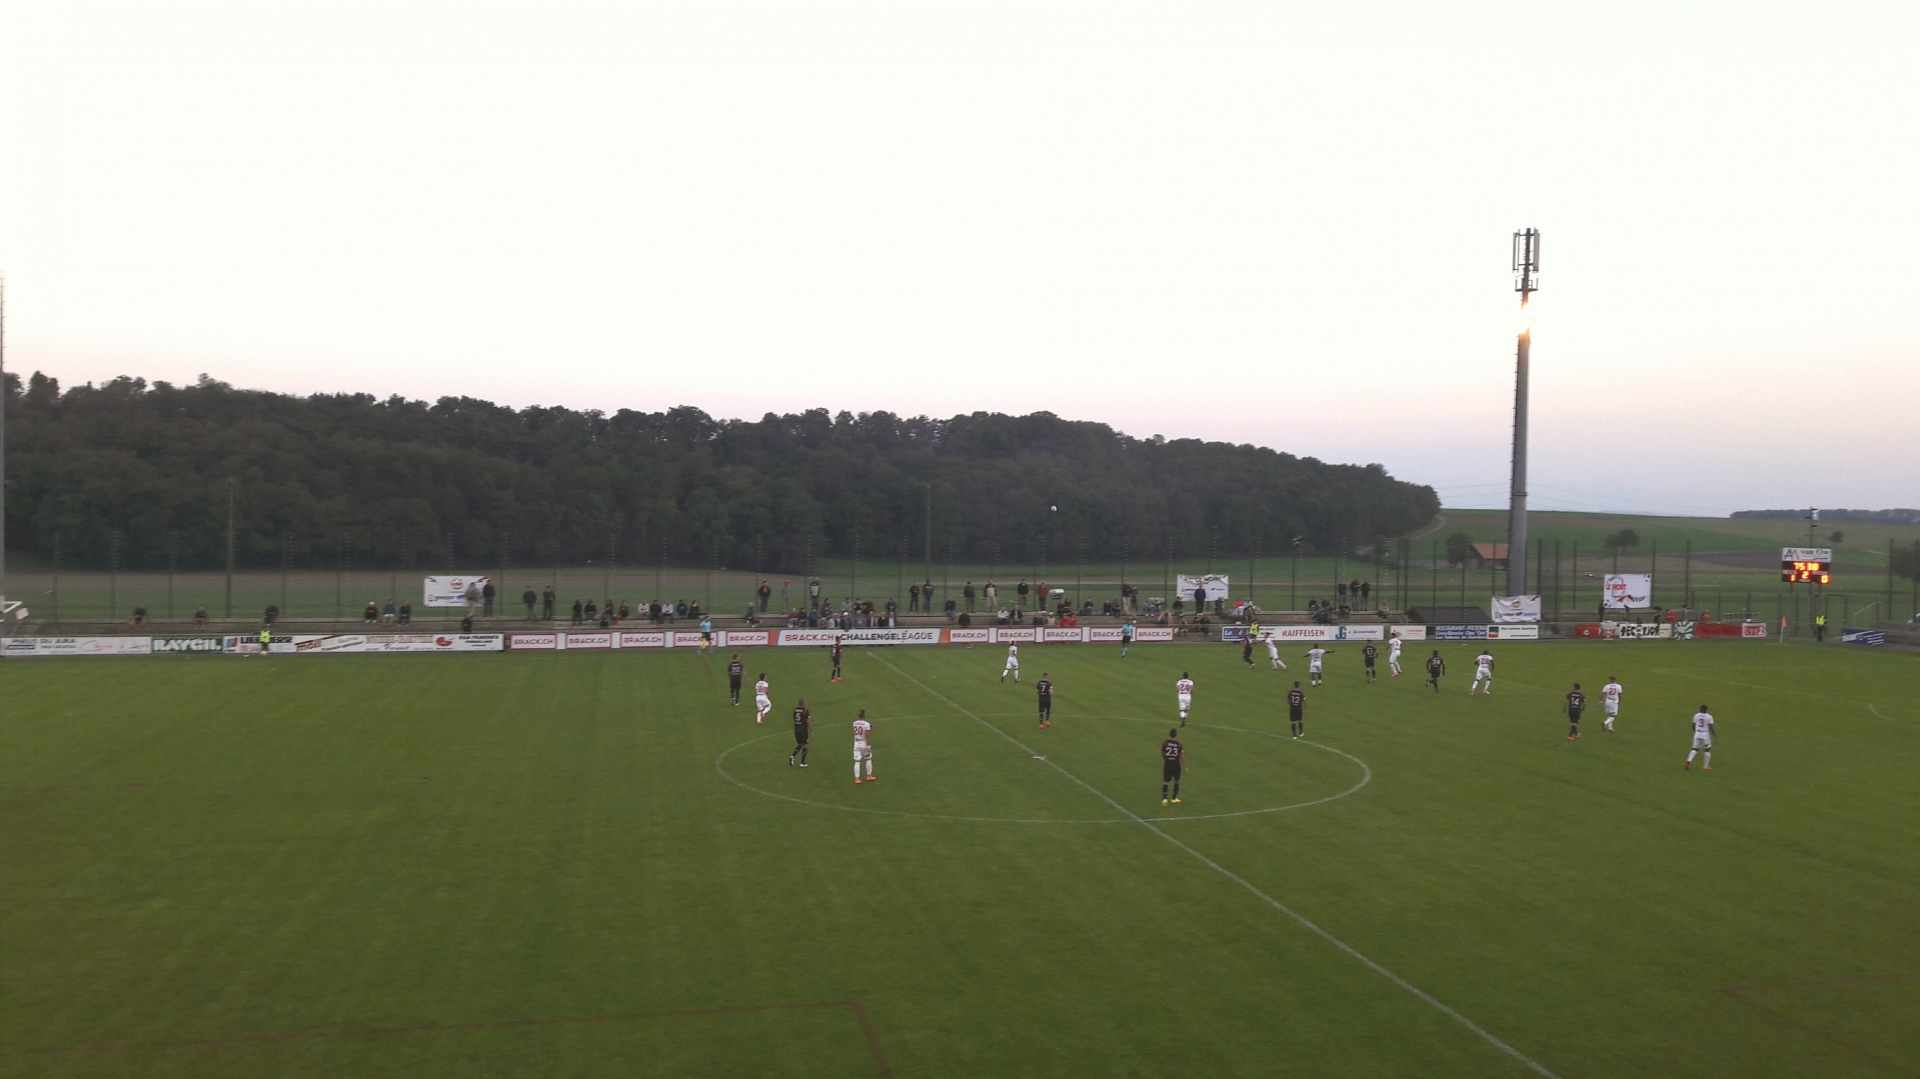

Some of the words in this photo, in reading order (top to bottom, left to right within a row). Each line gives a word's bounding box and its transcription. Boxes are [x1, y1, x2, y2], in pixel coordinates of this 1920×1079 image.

[1801, 571, 1809, 580] 2
[785, 633, 835, 642] BRACK.CH
[1282, 629, 1325, 637] RAIFFEISEN
[728, 634, 767, 642] BRACK.CH
[1291, 695, 1300, 704] 12
[795, 712, 801, 721] 5
[1698, 718, 1705, 728] 3
[853, 726, 863, 736] 20
[1165, 747, 1179, 757] 23
